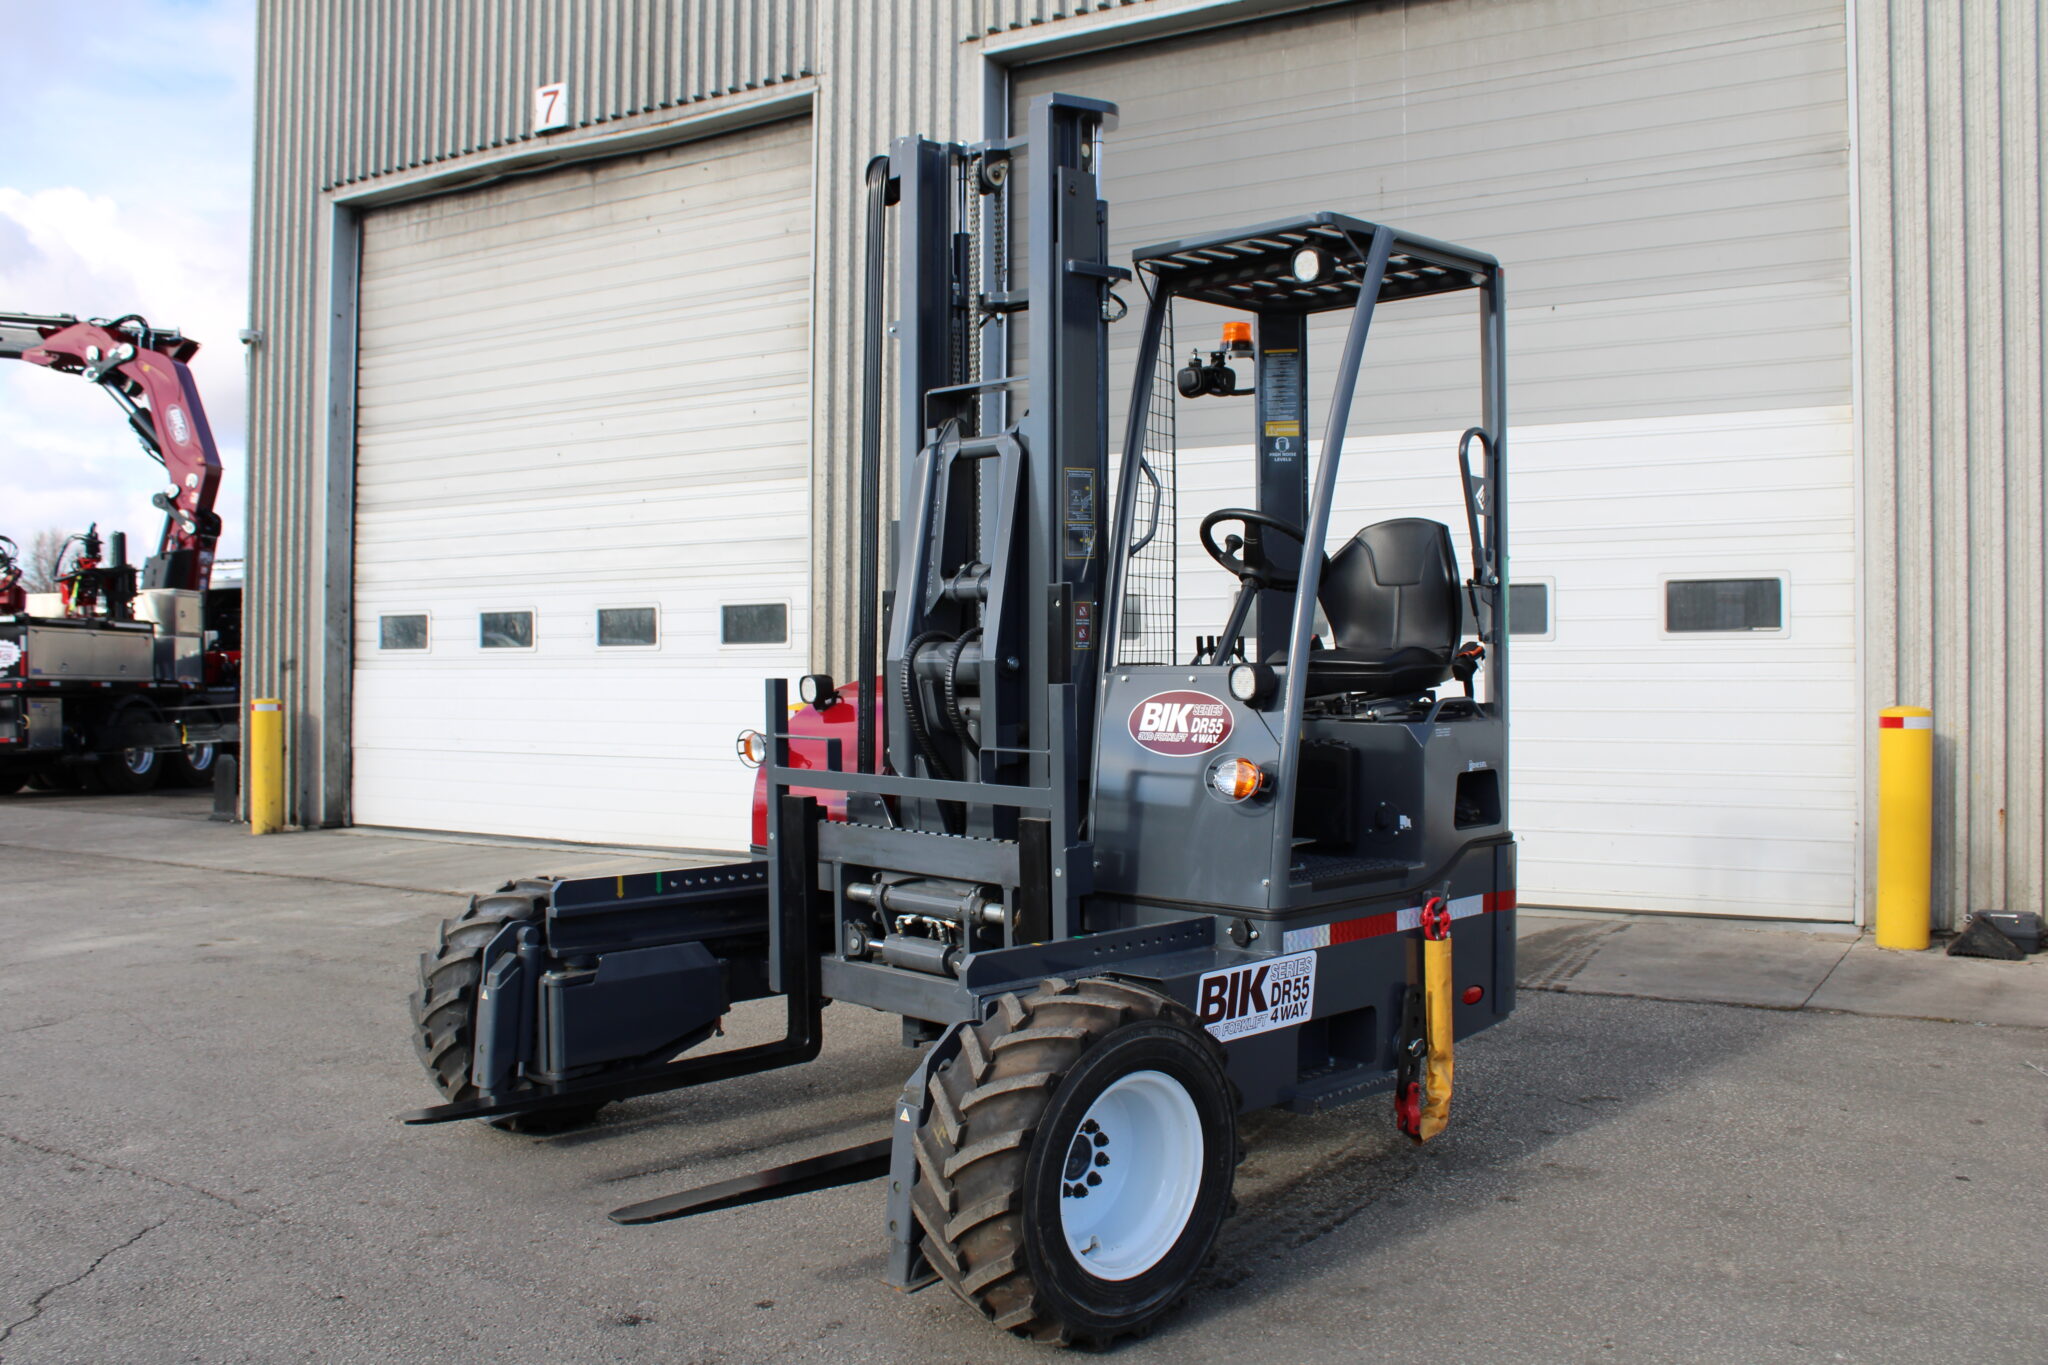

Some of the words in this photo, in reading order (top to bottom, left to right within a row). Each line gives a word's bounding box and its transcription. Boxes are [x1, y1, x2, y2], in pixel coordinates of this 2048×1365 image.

[543, 90, 559, 124] 7
[1139, 703, 1194, 733] BIK
[1193, 704, 1224, 716] SERIES
[1190, 717, 1225, 734] DR55
[1191, 734, 1198, 743] 4
[1270, 956, 1313, 981] SERIES
[1200, 965, 1271, 1025] BIK
[1270, 975, 1310, 1008] DR55
[1221, 1014, 1268, 1037] FORKLIFT
[1270, 1007, 1279, 1023] 4
